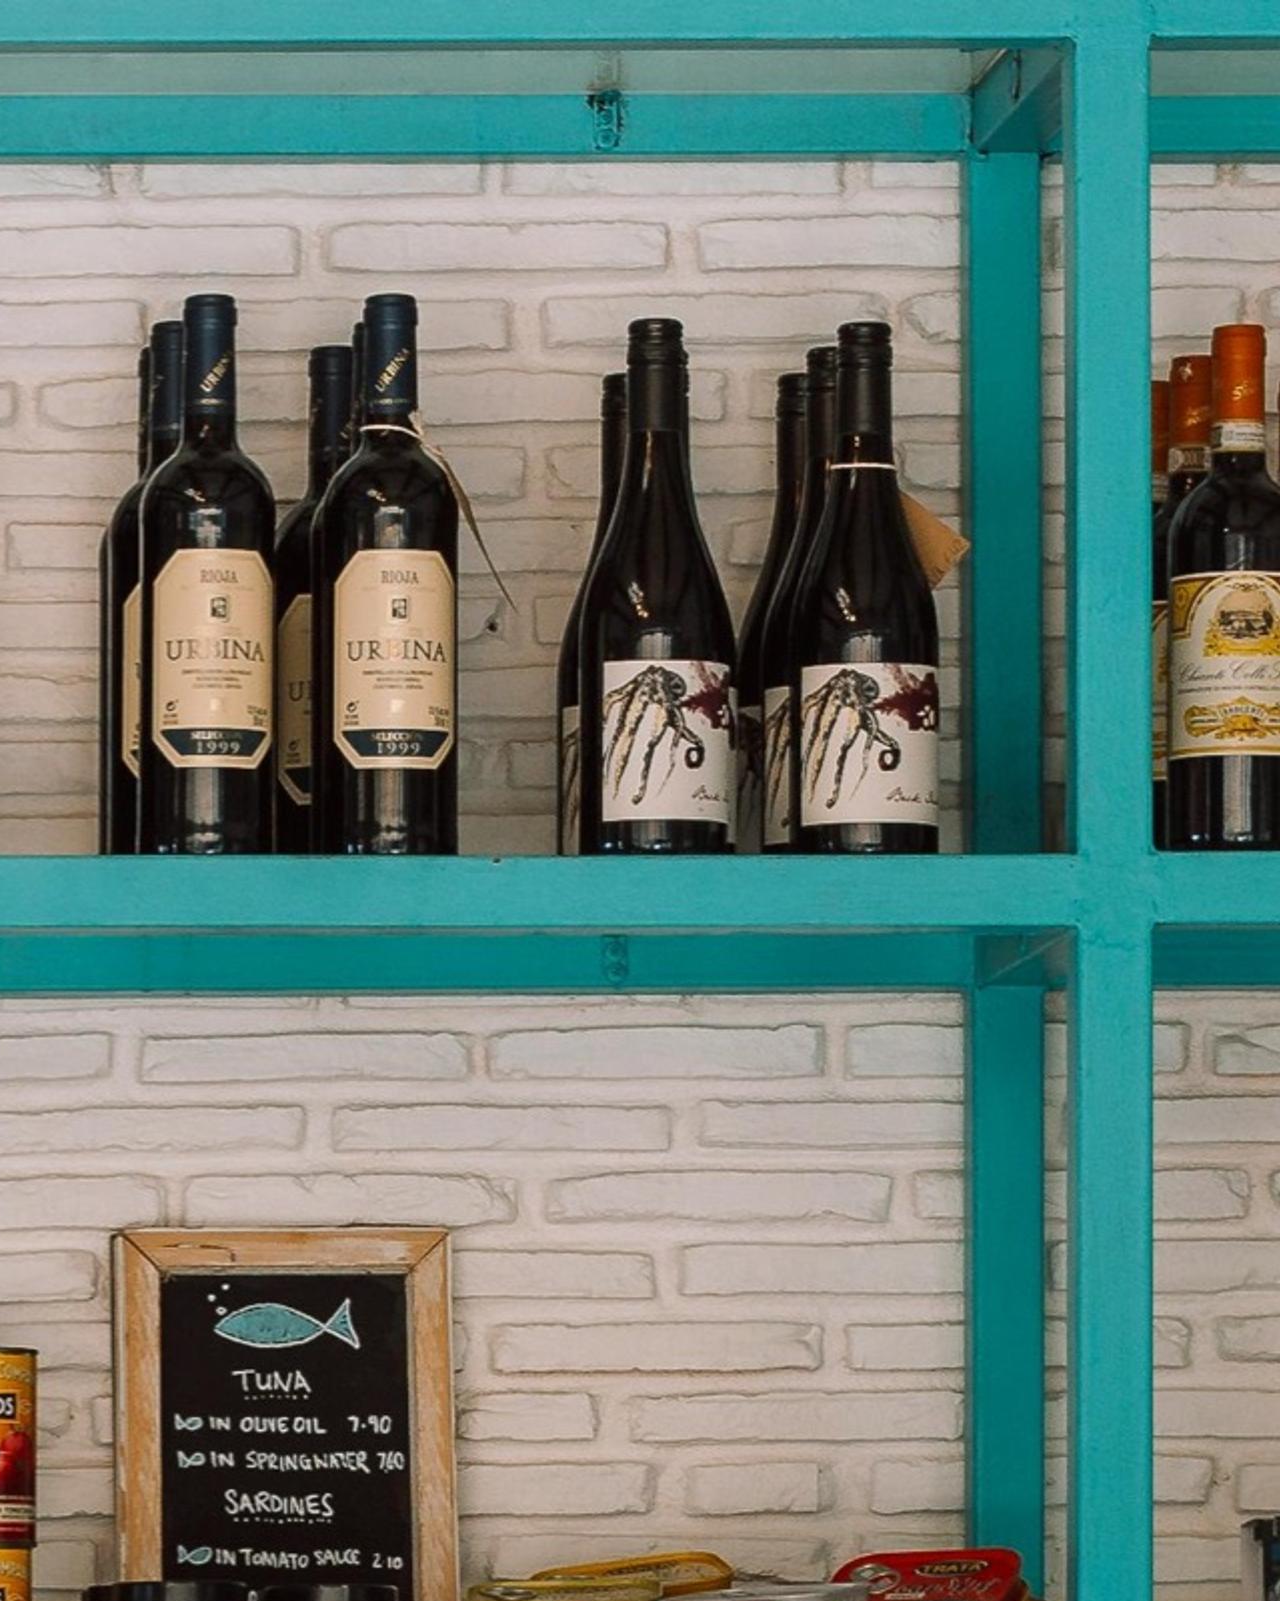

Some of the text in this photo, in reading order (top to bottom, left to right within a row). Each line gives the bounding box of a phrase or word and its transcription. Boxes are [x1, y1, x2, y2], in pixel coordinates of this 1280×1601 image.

[231, 1369, 313, 1393] TUNA
[209, 1416, 232, 1431] IN
[292, 1416, 327, 1434] OIL
[210, 1451, 236, 1467] IN
[223, 1488, 335, 1518] SARDINES
[215, 1549, 237, 1566] IN
[238, 1547, 310, 1570] TOMATO
